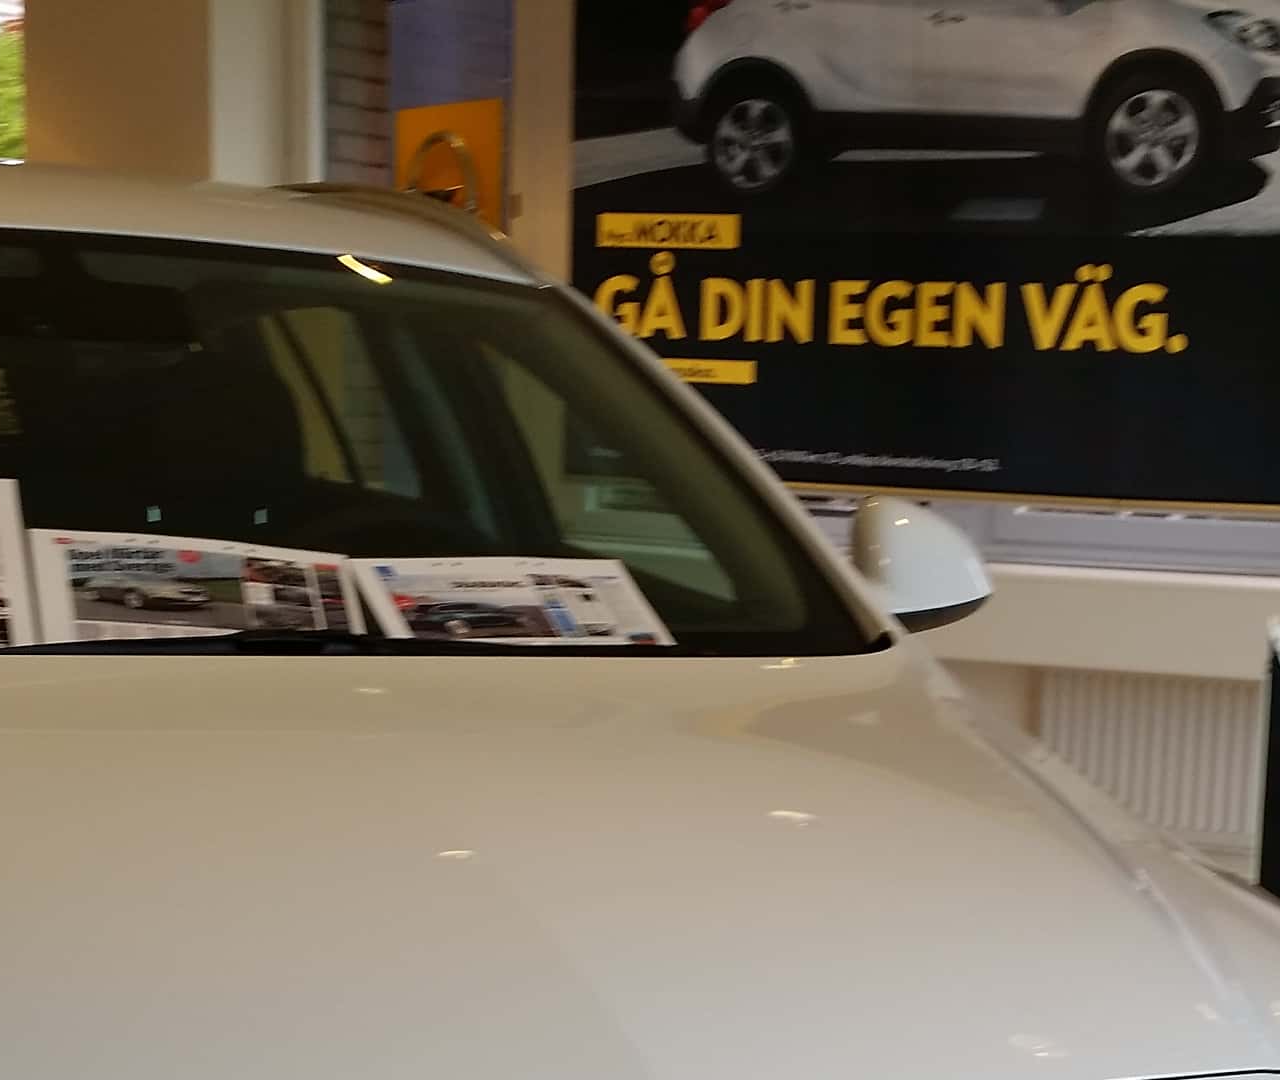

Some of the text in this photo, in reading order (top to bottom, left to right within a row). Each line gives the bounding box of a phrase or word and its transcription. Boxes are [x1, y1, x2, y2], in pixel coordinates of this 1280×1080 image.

[632, 219, 722, 244] MOKKA
[594, 251, 1188, 354] GÅ DIN EGEN VÄG.
